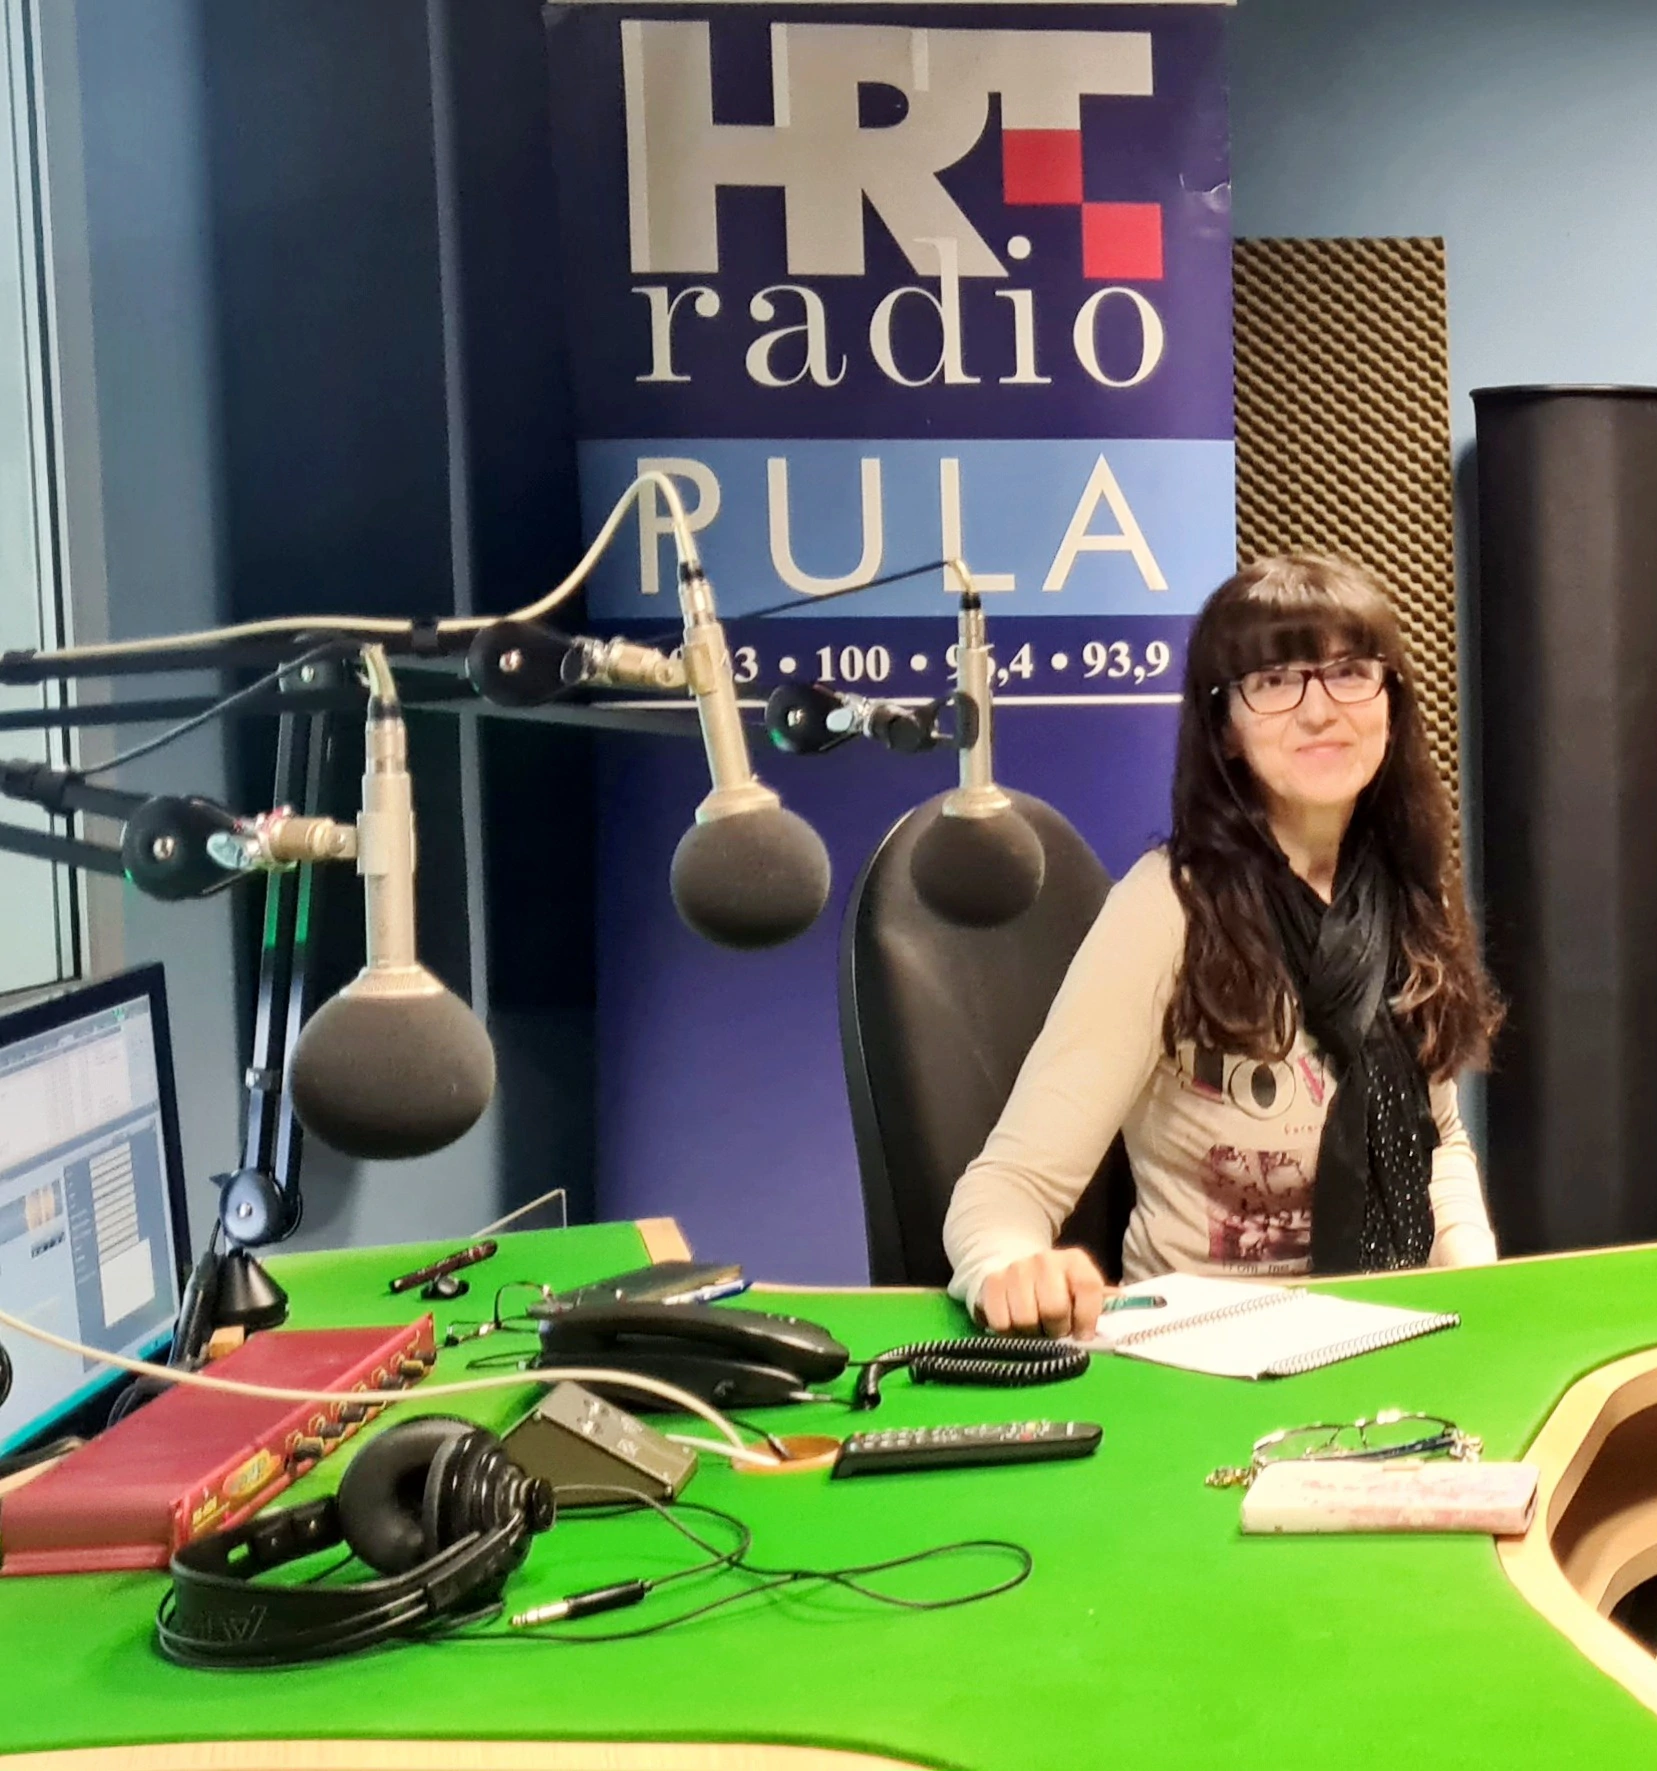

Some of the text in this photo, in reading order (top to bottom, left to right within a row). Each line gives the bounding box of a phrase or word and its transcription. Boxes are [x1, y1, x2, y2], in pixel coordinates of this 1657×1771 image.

[620, 19, 1163, 279] HRT
[632, 235, 1164, 388] radio
[636, 452, 1170, 595] PULA
[815, 645, 891, 683] 100
[1082, 640, 1171, 685] 93,9
